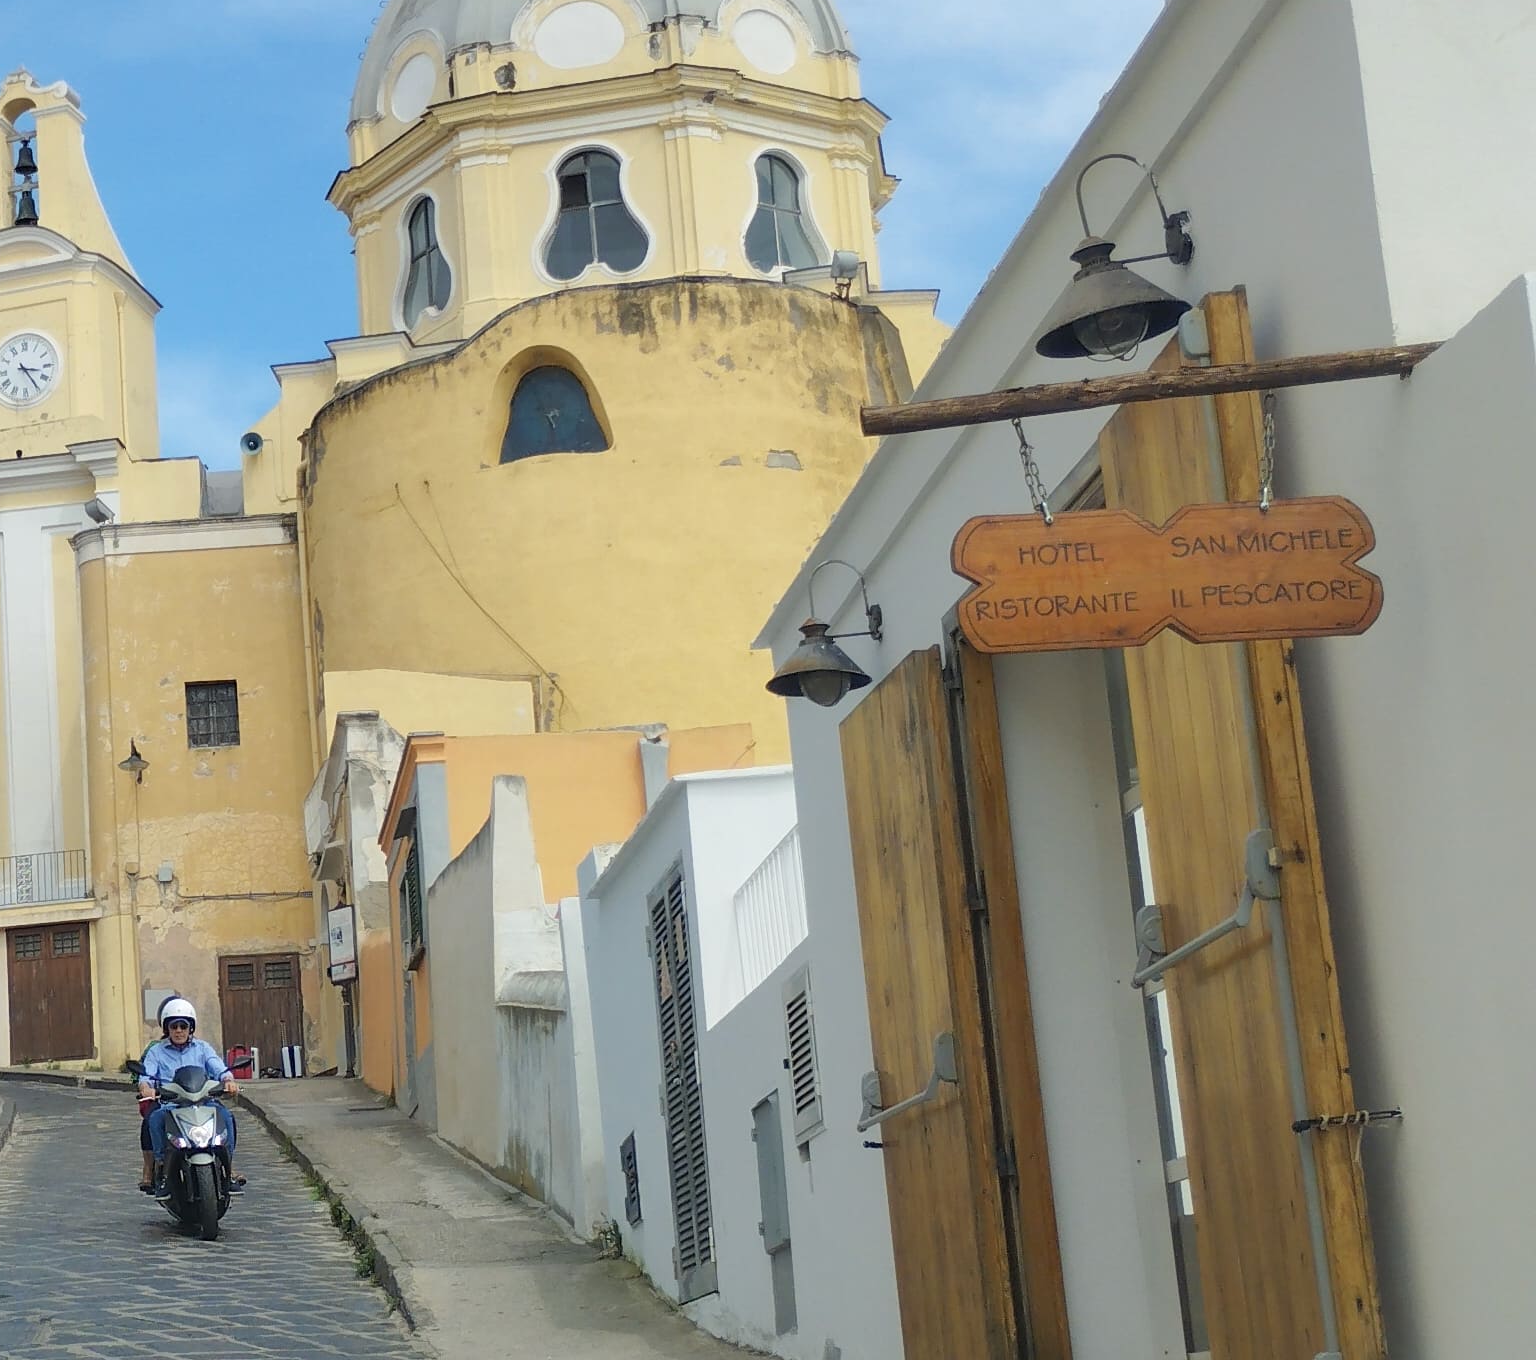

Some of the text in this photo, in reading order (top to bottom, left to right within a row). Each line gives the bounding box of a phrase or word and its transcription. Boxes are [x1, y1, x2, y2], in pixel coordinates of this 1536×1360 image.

[1018, 527, 1354, 566] HOTEL SAN MICHELE
[975, 578, 1365, 621] RISTORANTE IL PESCATORE
